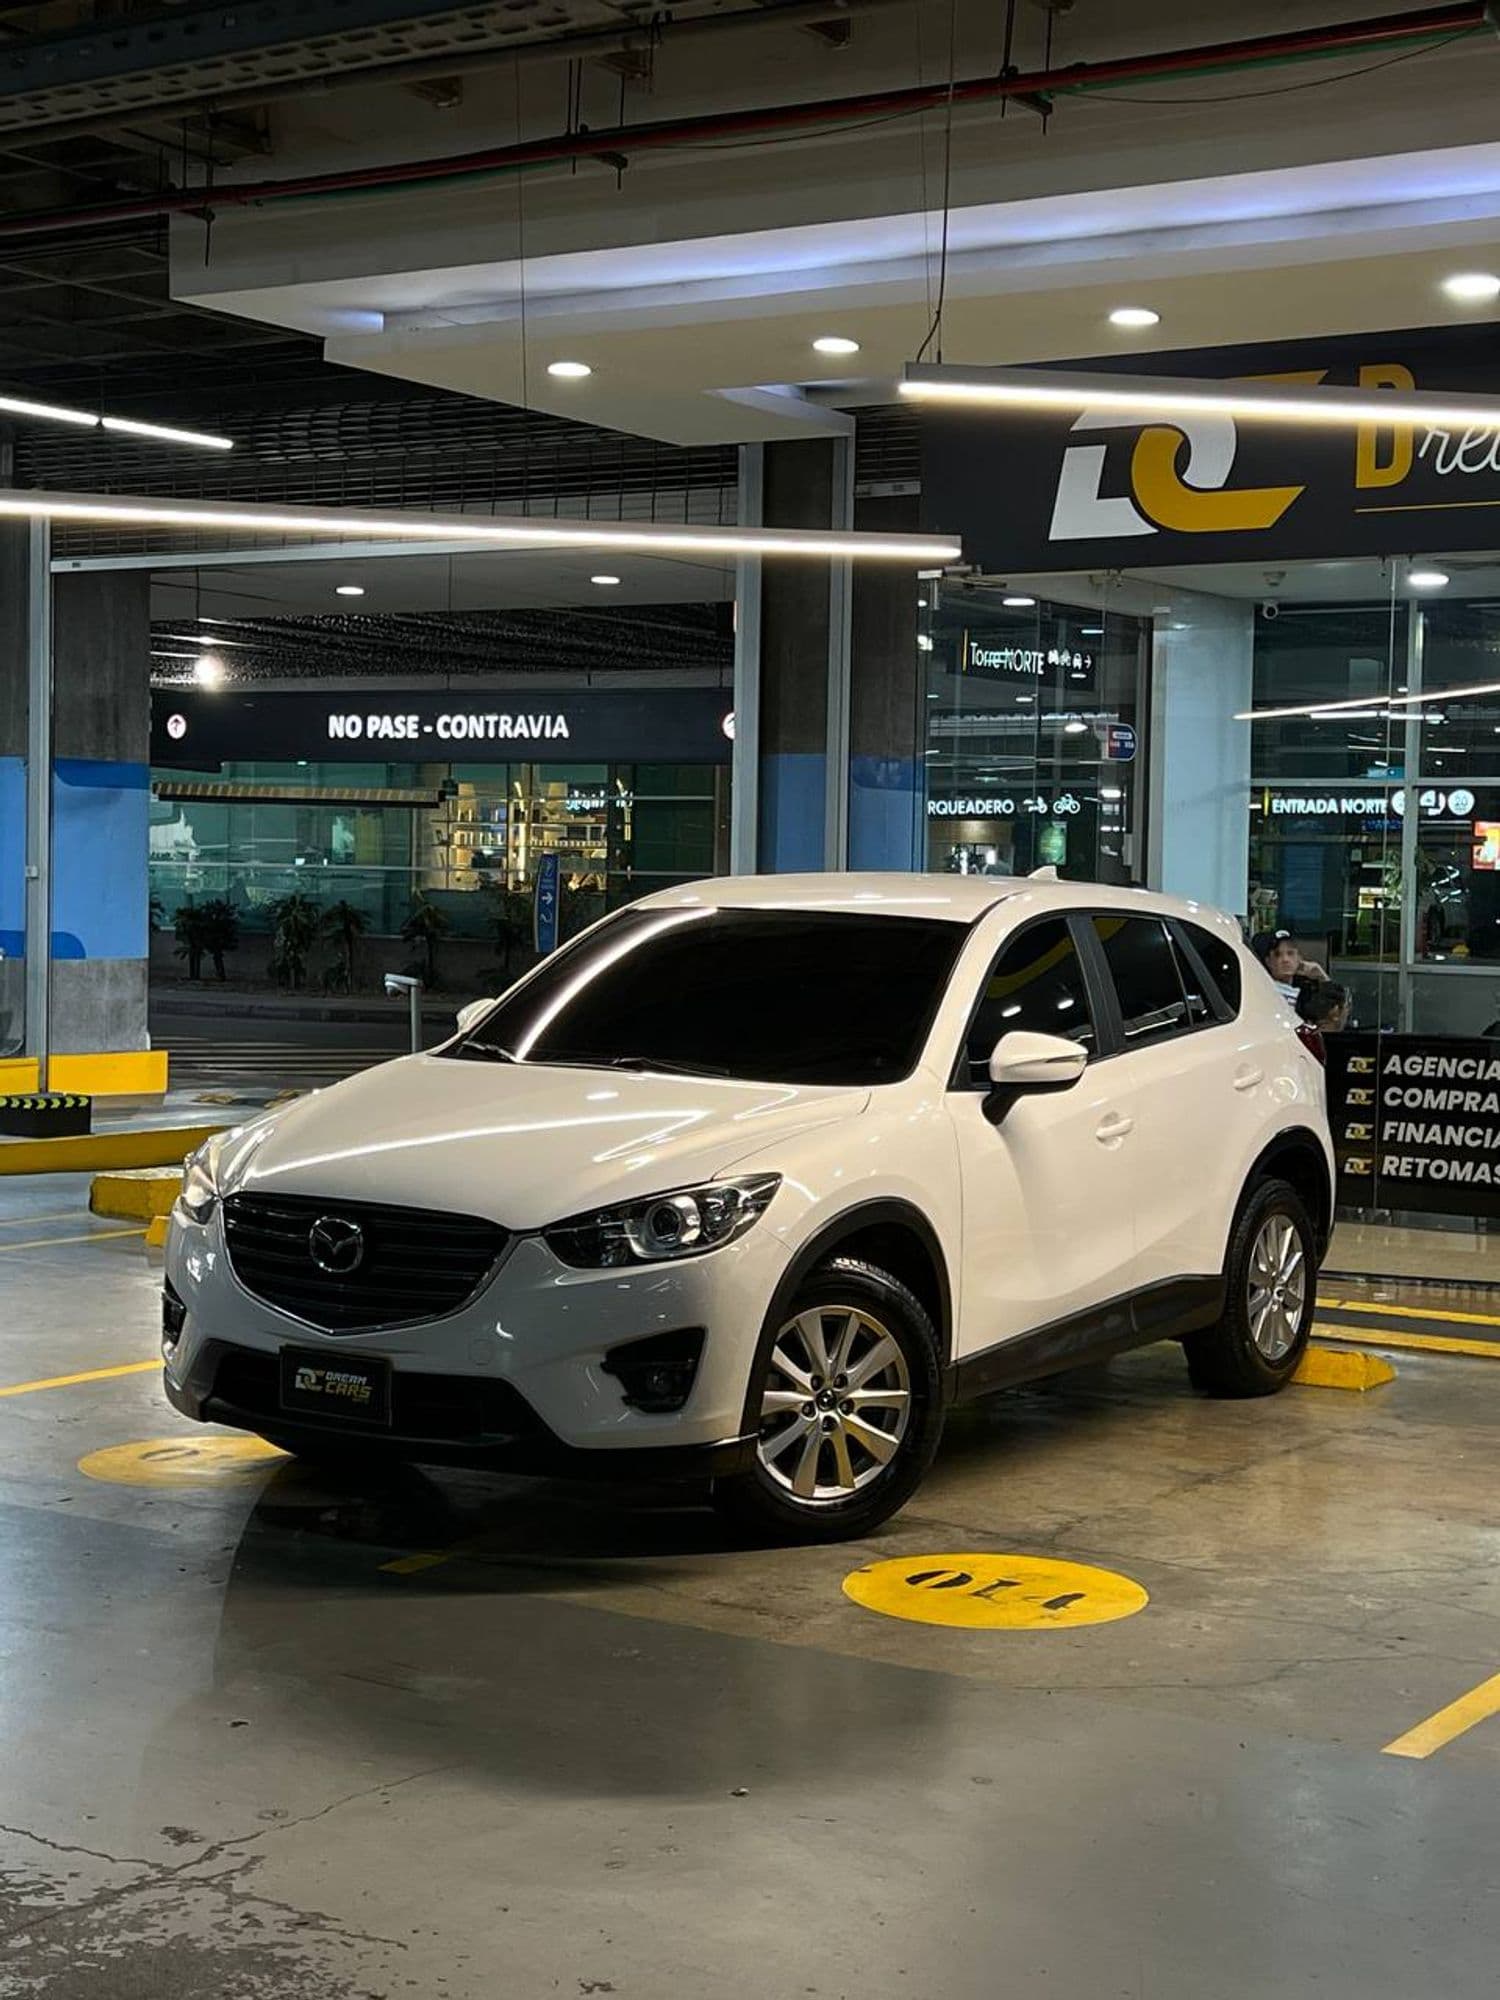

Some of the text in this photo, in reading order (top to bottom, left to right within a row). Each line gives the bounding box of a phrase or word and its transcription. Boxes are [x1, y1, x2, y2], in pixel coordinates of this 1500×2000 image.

[328, 714, 362, 738] NO
[367, 714, 419, 739] PASE
[436, 714, 570, 739] CONTRAVIA
[1272, 797, 1387, 815] ENTRADA NORTE
[1383, 1054, 1500, 1081] AGENCIA
[1384, 1086, 1500, 1114] COMPRA
[325, 1381, 373, 1399] CARS
